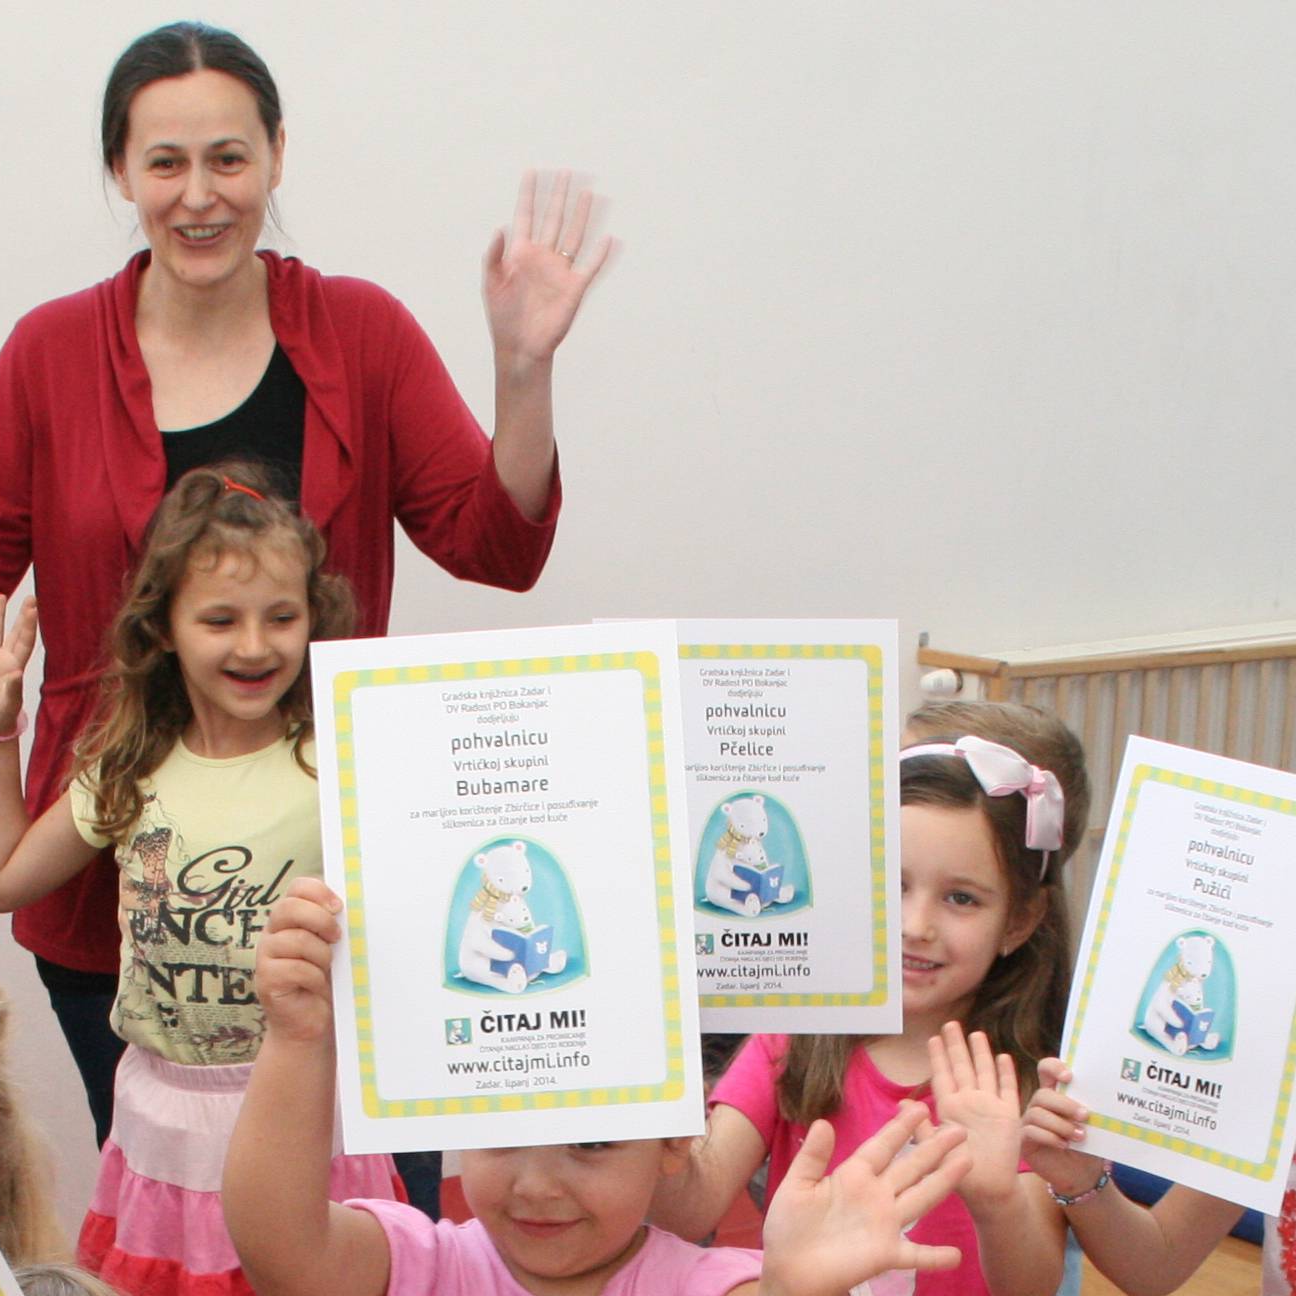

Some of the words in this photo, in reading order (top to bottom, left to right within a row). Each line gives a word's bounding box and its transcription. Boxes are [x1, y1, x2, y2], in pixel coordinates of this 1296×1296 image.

[706, 704, 786, 722] pohvalnicu
[749, 725, 786, 737] skupini
[451, 729, 548, 755] pohvalnicu
[720, 741, 774, 756] Pčelice
[504, 755, 548, 770] skupini
[456, 778, 549, 796] Bubamare
[1187, 839, 1255, 865] pohvalnicu
[177, 846, 294, 911] Girl
[721, 929, 771, 947] ČITAJ
[779, 933, 808, 946] MI!
[697, 964, 811, 979] www.citajmi.info
[480, 1010, 541, 1033] ČITAJ
[550, 1010, 586, 1029] MI!
[447, 1051, 590, 1075] www.citajmi.info
[1147, 1060, 1191, 1089] ČITAJ
[1195, 1078, 1223, 1099] MI!
[1117, 1092, 1217, 1130] www.citajmi.info
